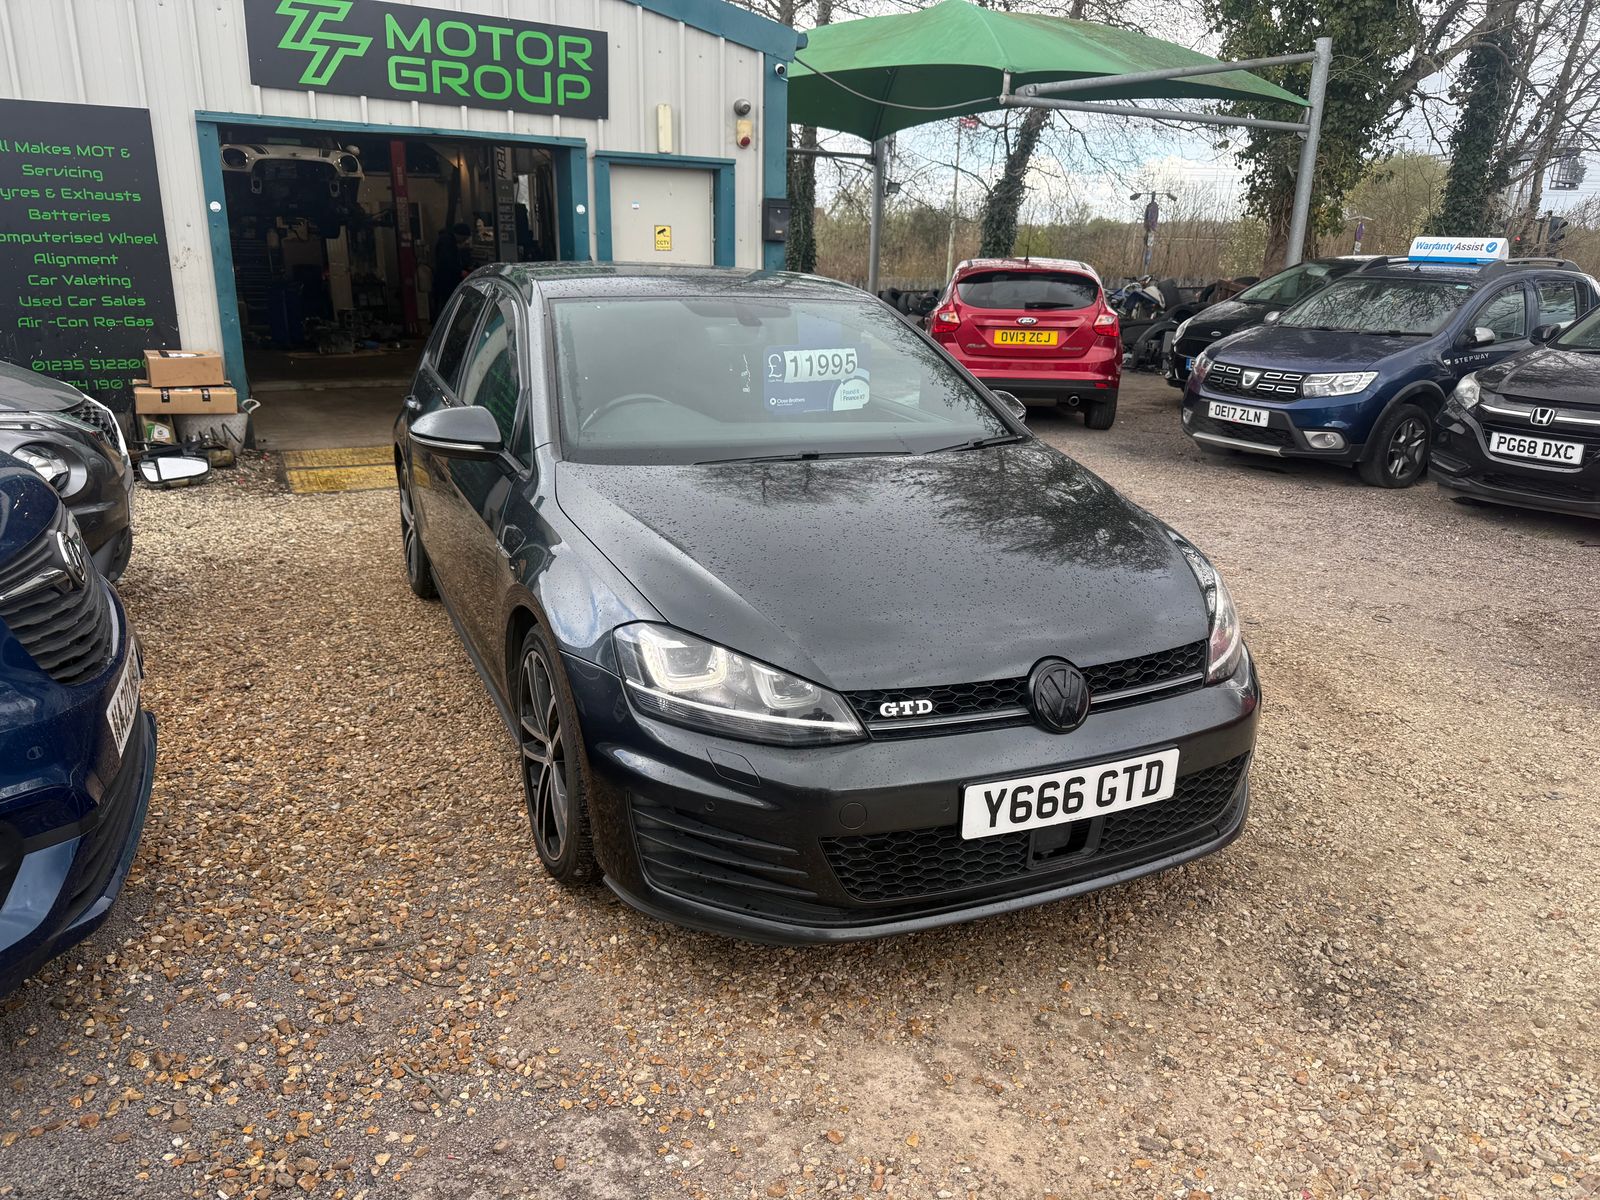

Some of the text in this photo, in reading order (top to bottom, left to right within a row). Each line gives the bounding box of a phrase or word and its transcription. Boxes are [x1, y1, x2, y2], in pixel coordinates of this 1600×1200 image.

[385, 13, 594, 72] MOTOR
[387, 55, 592, 106] GROUP
[0, 139, 131, 159] ll Makes MOT &
[22, 164, 104, 182] Servicing
[0, 187, 142, 202] yres & Exhausts
[28, 208, 111, 222] Batteries
[0, 231, 159, 245] omputerised Wheel
[1415, 241, 1485, 253] WarrantyAssist
[34, 253, 119, 268] Alignment
[27, 274, 133, 289] Car Valeting
[18, 295, 146, 307] Used Car Sales
[17, 316, 43, 328] Air
[93, 316, 155, 328] Re-Gas
[1001, 331, 1051, 343] OV13 ZCJ
[31, 359, 85, 371] 01235
[1454, 352, 1490, 365] STEPWAY
[94, 379, 123, 390] 190
[1214, 404, 1262, 424] OE17 ZLN
[1496, 436, 1575, 460] PG68 DXC
[879, 699, 933, 717] GTD
[983, 759, 1165, 828] Y666 GTD
